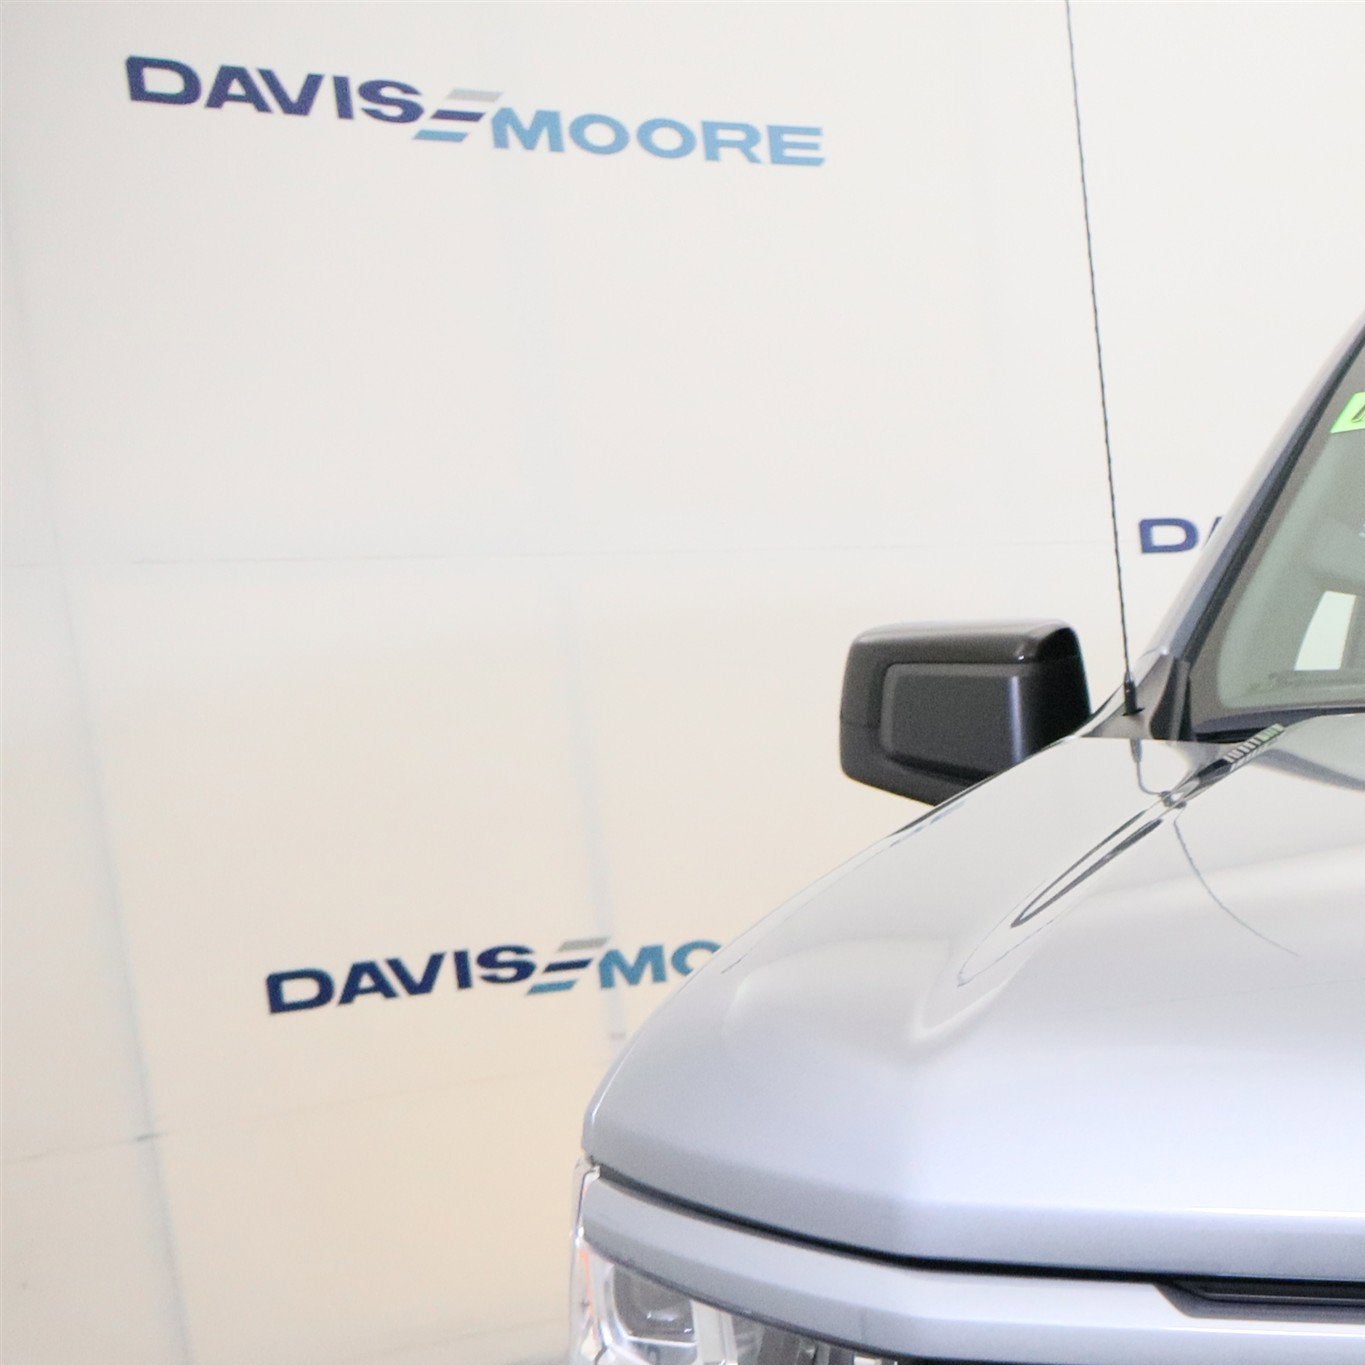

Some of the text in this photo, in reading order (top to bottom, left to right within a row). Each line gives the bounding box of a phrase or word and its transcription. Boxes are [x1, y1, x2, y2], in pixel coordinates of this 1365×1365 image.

[125, 55, 825, 167] DAVIS MOORE
[265, 944, 538, 1014] DAVIS
